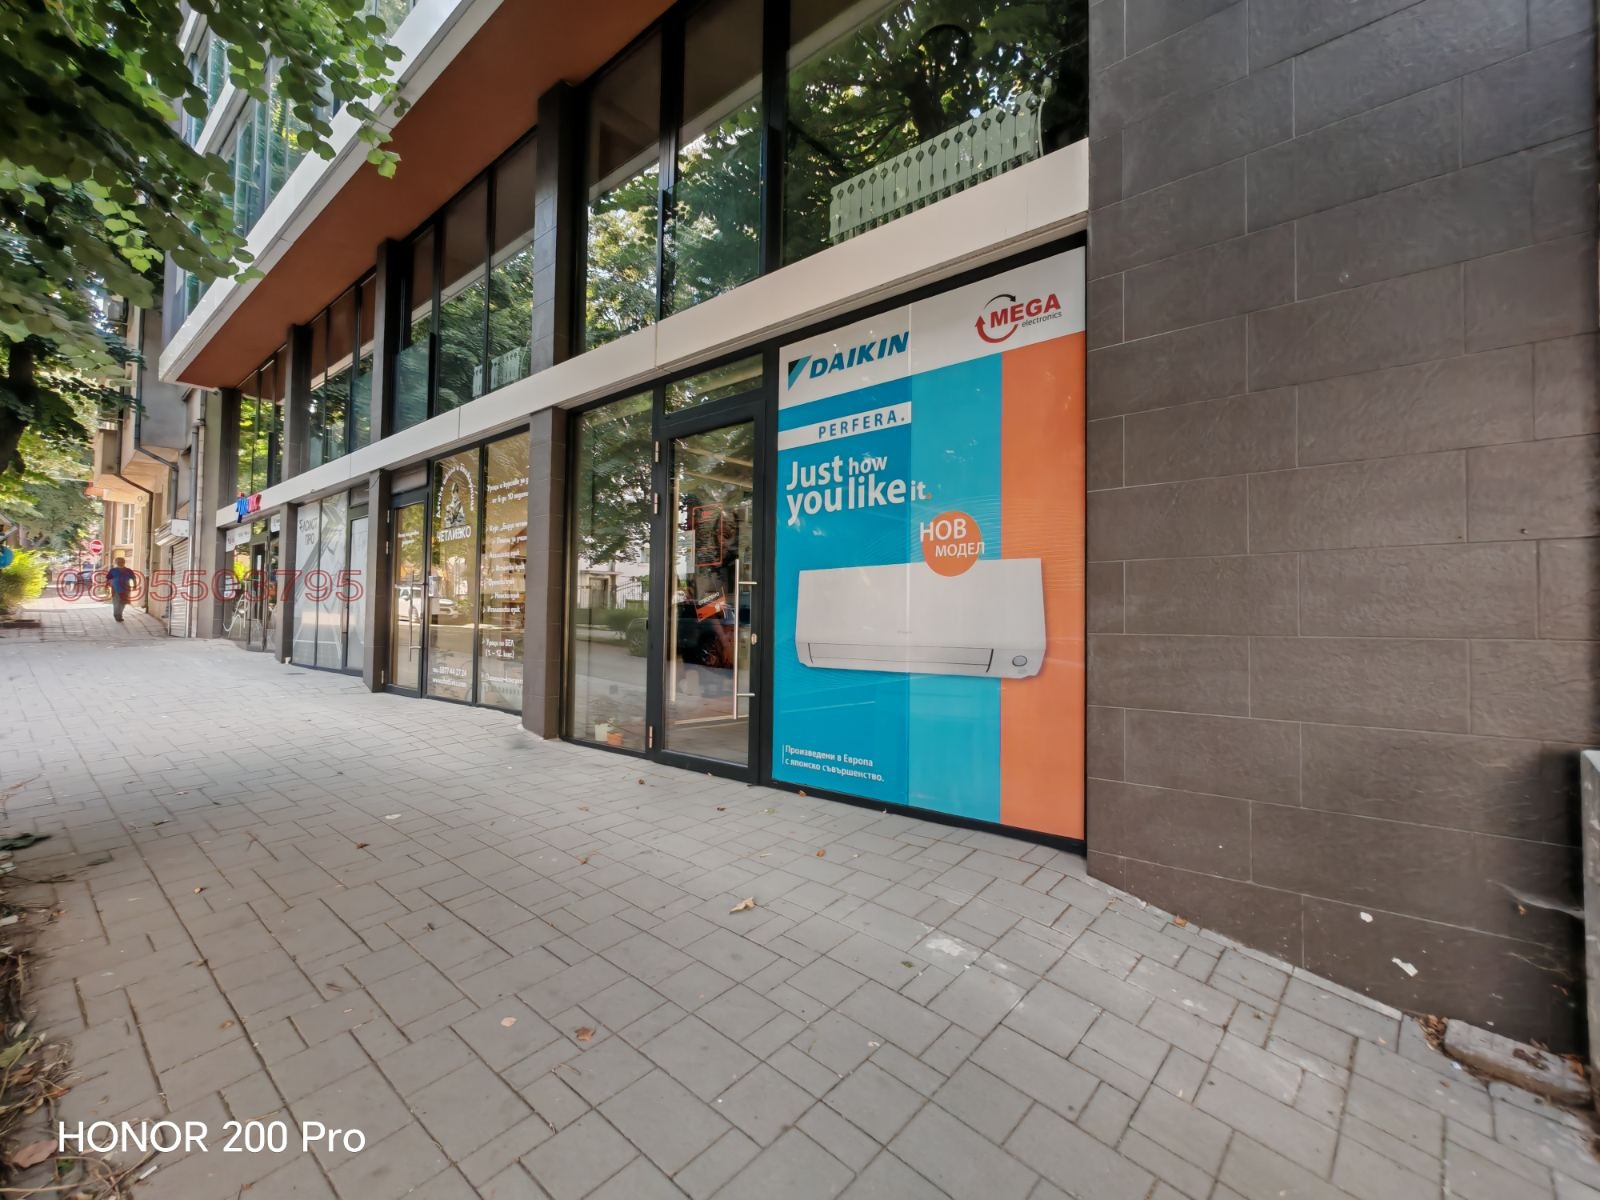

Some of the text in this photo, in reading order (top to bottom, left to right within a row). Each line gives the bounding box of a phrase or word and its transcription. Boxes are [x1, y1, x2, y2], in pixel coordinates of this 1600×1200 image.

[989, 293, 1061, 329] MEGA
[1021, 311, 1063, 328] electronics
[808, 331, 910, 379] DAIKIN
[786, 455, 888, 491] Just how
[786, 487, 843, 526] you
[848, 474, 905, 510] like
[919, 518, 967, 543] НОВ
[935, 541, 985, 558] МОДЕЛ
[785, 744, 874, 767] Произведени в Европа
[790, 759, 821, 771] японско
[822, 763, 885, 782] съвършенство.
